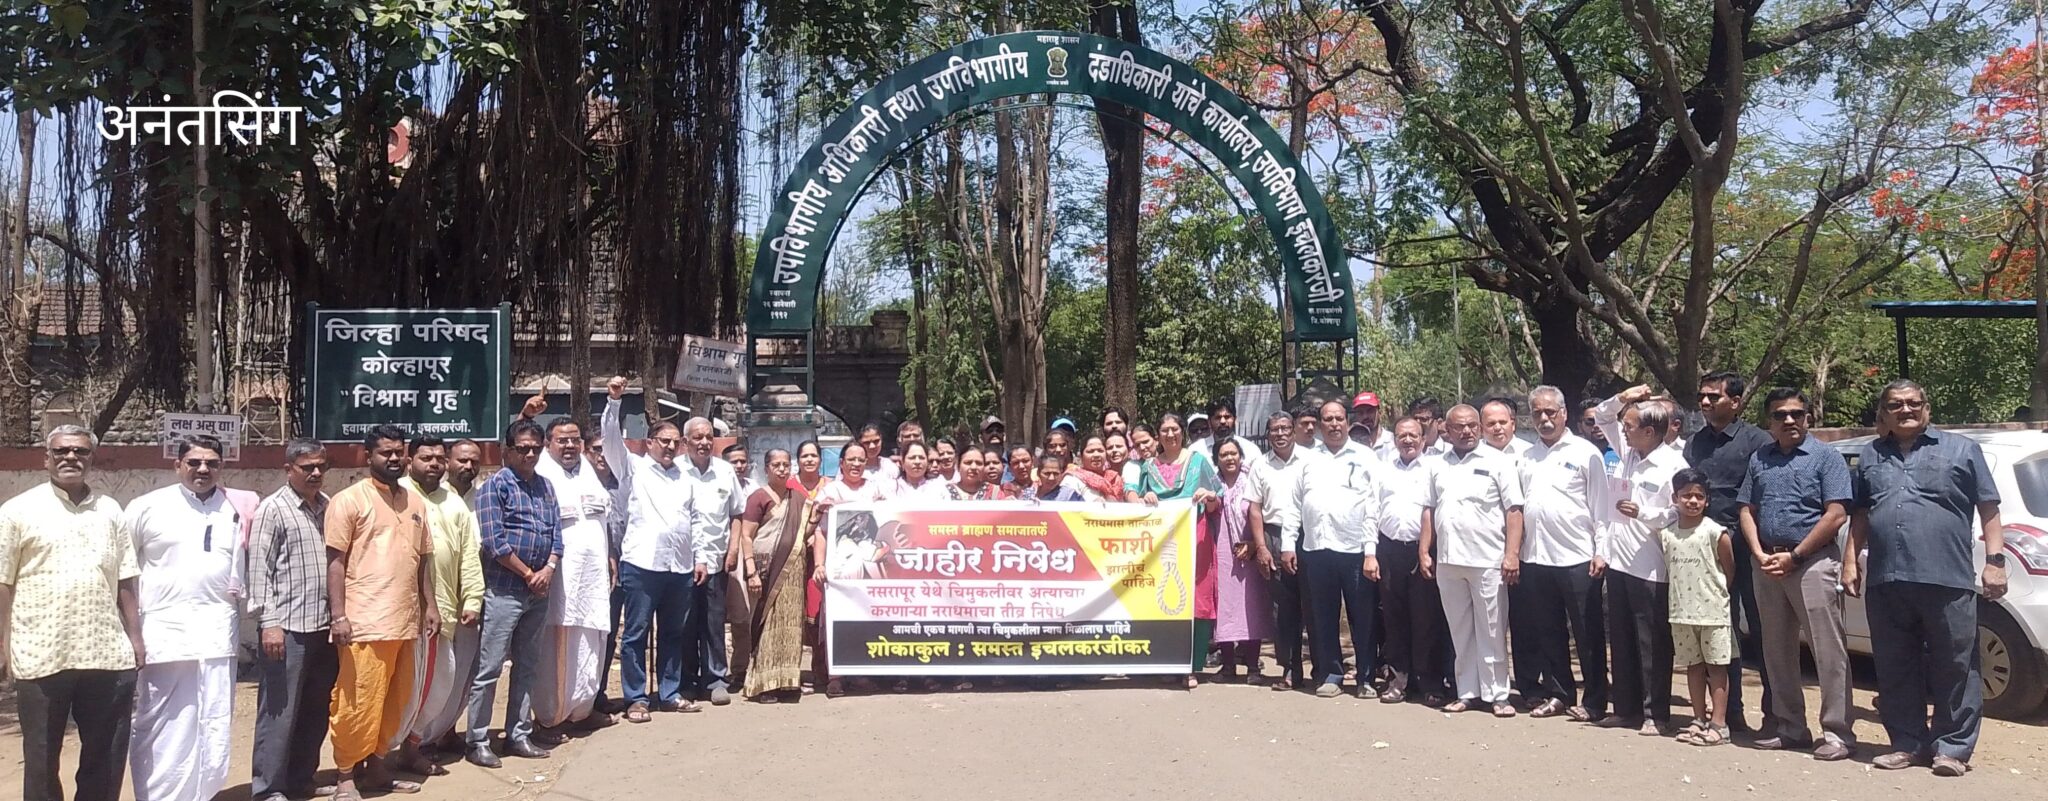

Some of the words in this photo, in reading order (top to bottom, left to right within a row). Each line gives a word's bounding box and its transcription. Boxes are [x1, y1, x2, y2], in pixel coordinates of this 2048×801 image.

[1036, 35, 1059, 45] महाराष्ट्र
[1061, 36, 1080, 44] शासन
[770, 178, 833, 284] उपविभागीय
[818, 104, 891, 183] अधिकारी
[882, 84, 926, 122] तथा
[922, 42, 1028, 100] उपविभागीय
[1088, 43, 1172, 100] दंडाधिकारी
[1171, 78, 1207, 117] यांचे
[1202, 100, 1263, 169] कार्यालय,
[1252, 149, 1307, 221] उपविभाग
[1284, 217, 1345, 303] इचलकरंजी
[325, 318, 403, 345] जिल्हा
[412, 318, 490, 344] परिषद
[688, 341, 728, 361] विश्राम
[361, 350, 451, 382] कोल्हापूर
[170, 418, 193, 430] लक्ष
[195, 420, 218, 434] असू
[417, 419, 471, 434] इचलकरंजी.
[928, 525, 959, 536] समस्त
[961, 525, 994, 537] ब्राह्मण
[1083, 518, 1125, 528] नराधमास
[1098, 531, 1154, 555] फाशी
[894, 540, 983, 577] जाहीर
[991, 540, 1077, 574] निषेध
[1120, 574, 1155, 588] पाहिजे
[866, 586, 915, 603] नसरापूर
[920, 581, 942, 598] येथे
[948, 581, 1023, 603] चिमुकलीवर
[1030, 587, 1085, 599] अत्याचार
[931, 605, 995, 618] नराधमाचा
[1000, 602, 1025, 618] तीव्र
[1031, 602, 1065, 618] निषेध
[892, 622, 921, 635] आमची
[923, 625, 946, 637] एकच
[947, 622, 975, 635] मागणी
[976, 626, 991, 635] त्या
[993, 622, 1041, 639] चिमुकलीला
[1042, 626, 1062, 634] न्याय
[1064, 623, 1103, 634] मिळालाच
[1105, 621, 1132, 634] पाहिजे
[866, 635, 951, 662] शोकाकुल
[970, 641, 1024, 657] समस्त
[1029, 634, 1151, 660] इचलकरंजीकर
